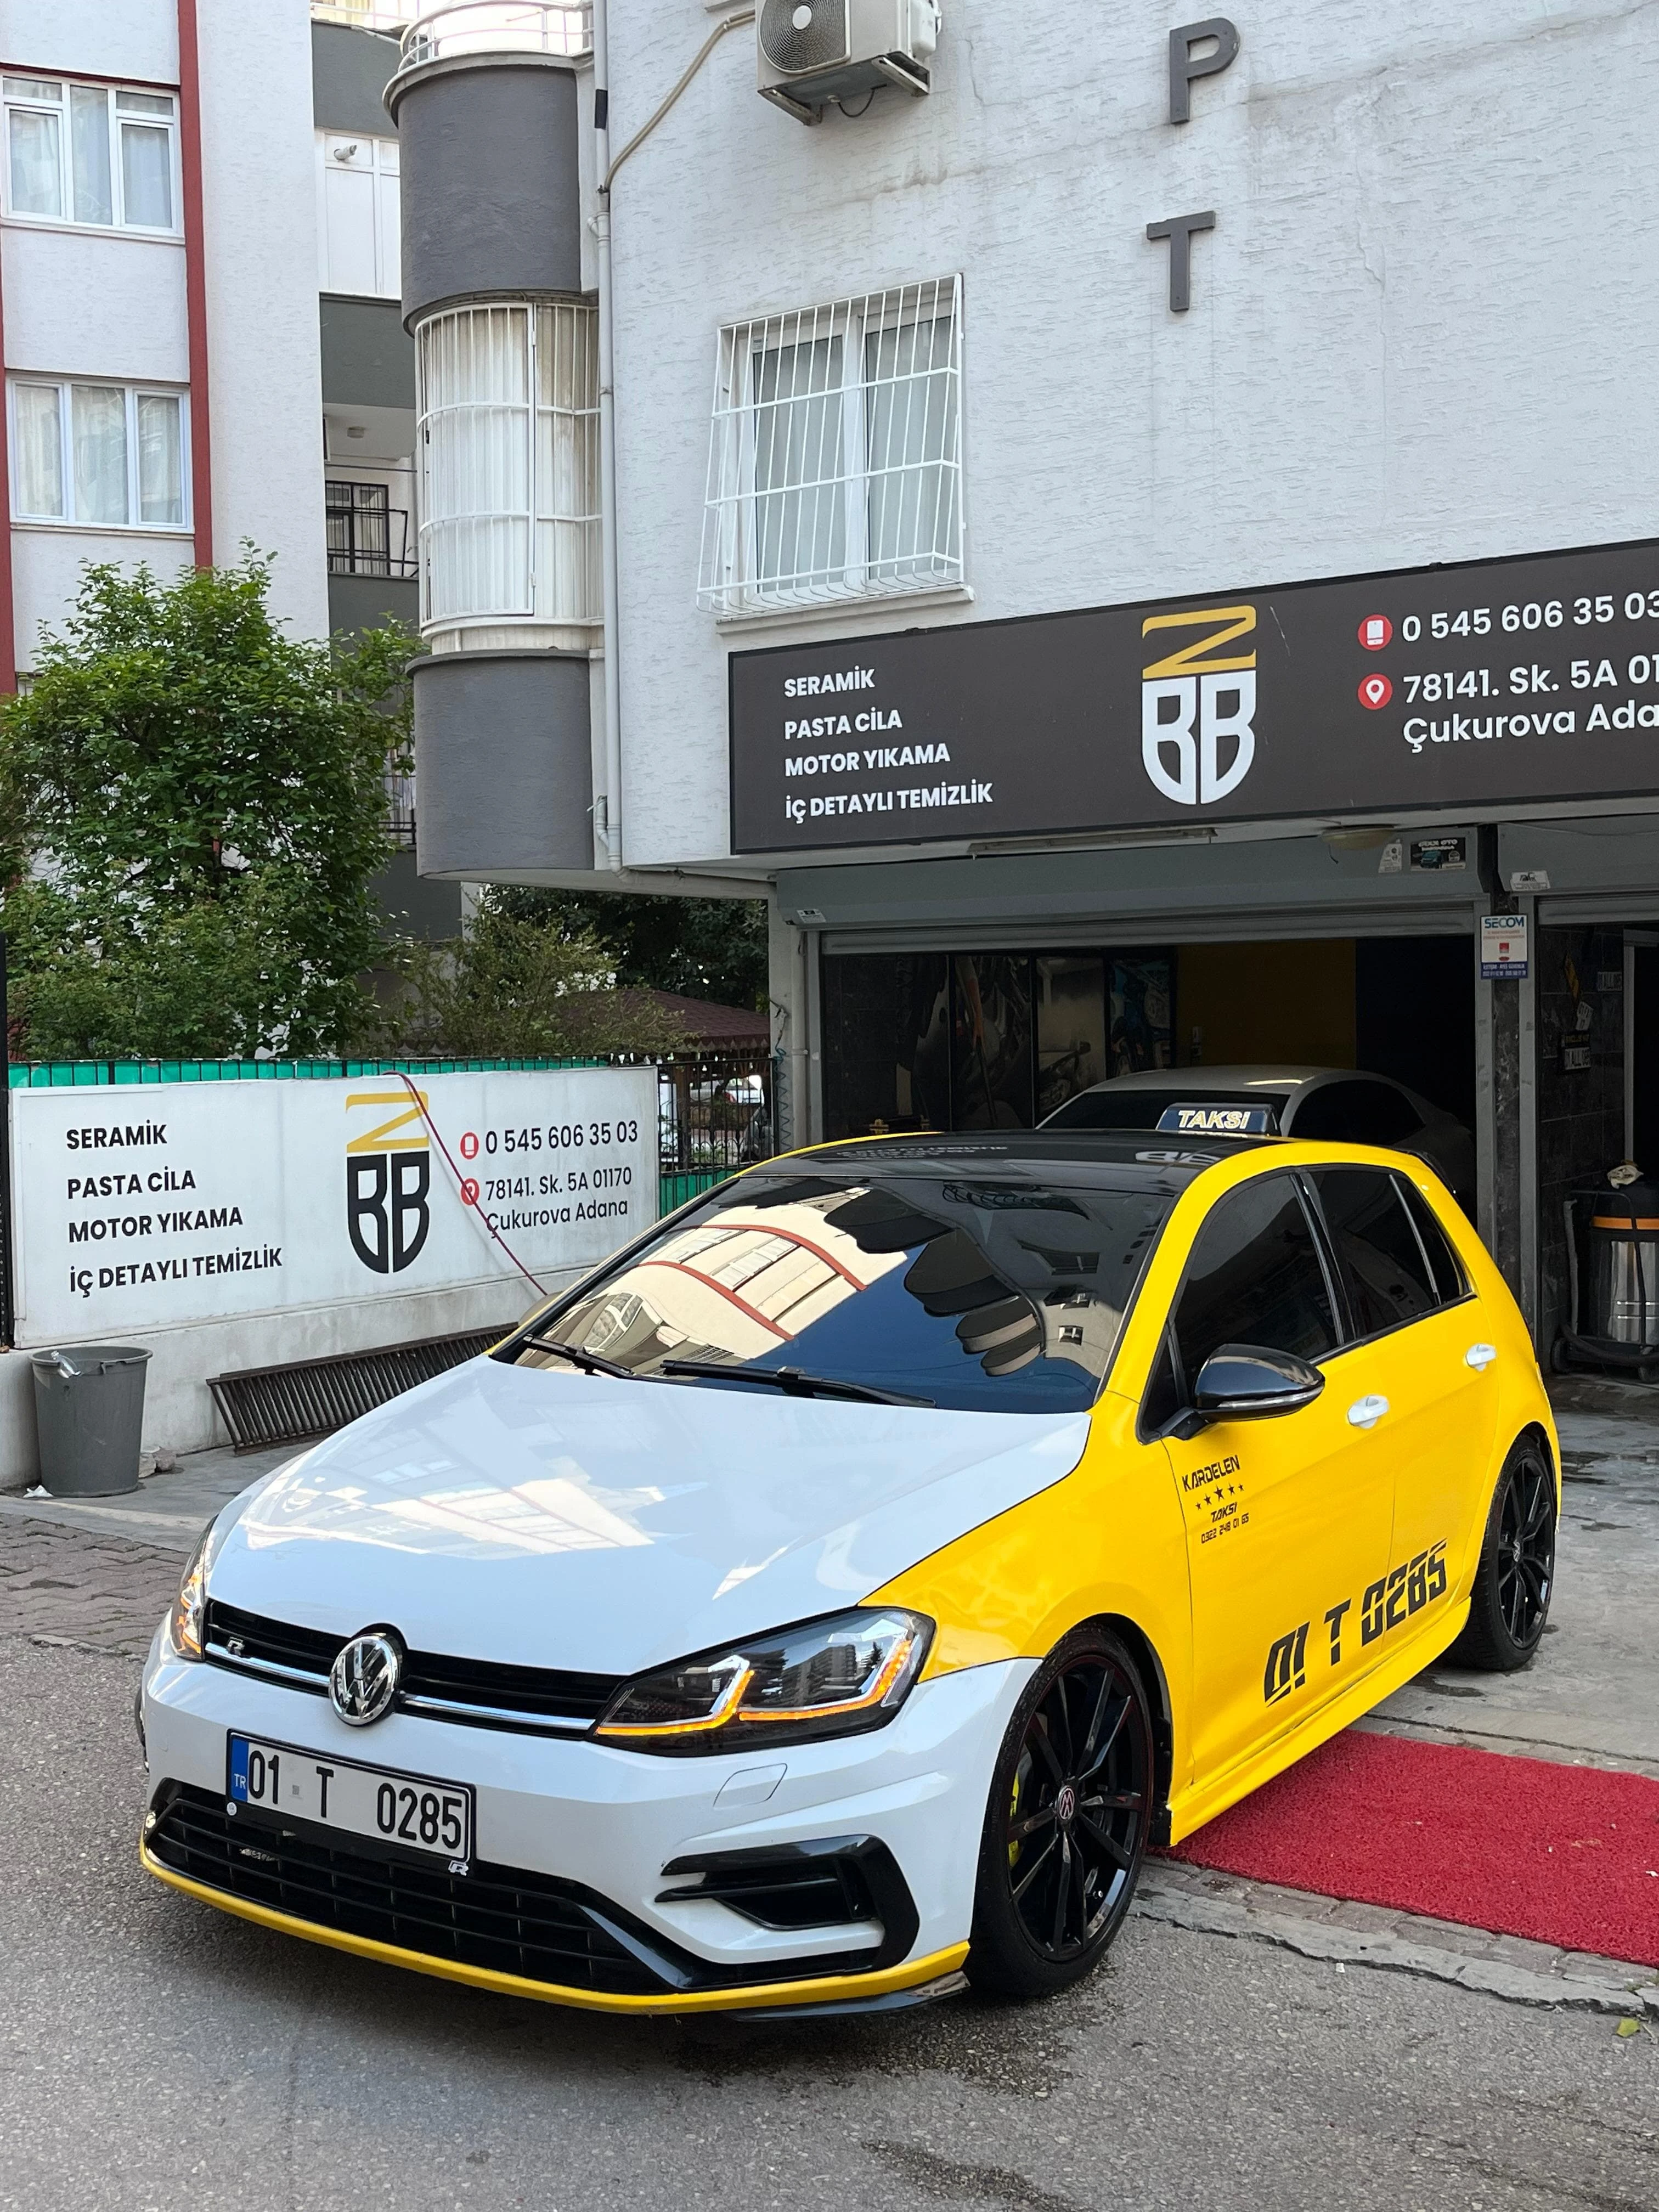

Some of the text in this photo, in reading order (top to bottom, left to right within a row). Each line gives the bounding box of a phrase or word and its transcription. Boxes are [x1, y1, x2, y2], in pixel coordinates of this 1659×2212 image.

[1170, 17, 1240, 125] P
[1146, 210, 1216, 312] T
[1402, 616, 1421, 642] 0
[1431, 608, 1492, 639] 545
[1501, 601, 1563, 633] 606
[1573, 595, 1615, 625] 35
[785, 665, 875, 697] SERAMİK
[1403, 669, 1500, 704] 78141.
[1509, 664, 1560, 695] Sk.
[1570, 659, 1618, 690] 5A
[785, 706, 902, 740] PASTA CİLA
[1403, 709, 1576, 753] Çukurova
[785, 743, 950, 777] MOTOR YIKAMA
[786, 778, 993, 824] İÇ DETAYLI TEMİZLİK
[66, 1119, 167, 1149] SERAMİK
[486, 1120, 639, 1153] 0 545 606 35 03
[1178, 1109, 1251, 1130] TAKSI
[67, 1166, 196, 1199] PASTA CİLA
[485, 1166, 632, 1201] 78141. Sk. 5A 01170
[69, 1206, 244, 1243] MOTOR YIKAMA
[486, 1199, 628, 1239] Çukurova Adana
[70, 1244, 283, 1298] İÇ DETAYLI TEMİZLİK
[1182, 1454, 1240, 1492] KARDELEN
[1323, 1598, 1352, 1666] T
[1361, 1537, 1447, 1647] 0285
[233, 1750, 462, 1849] TR 01 T 0285
